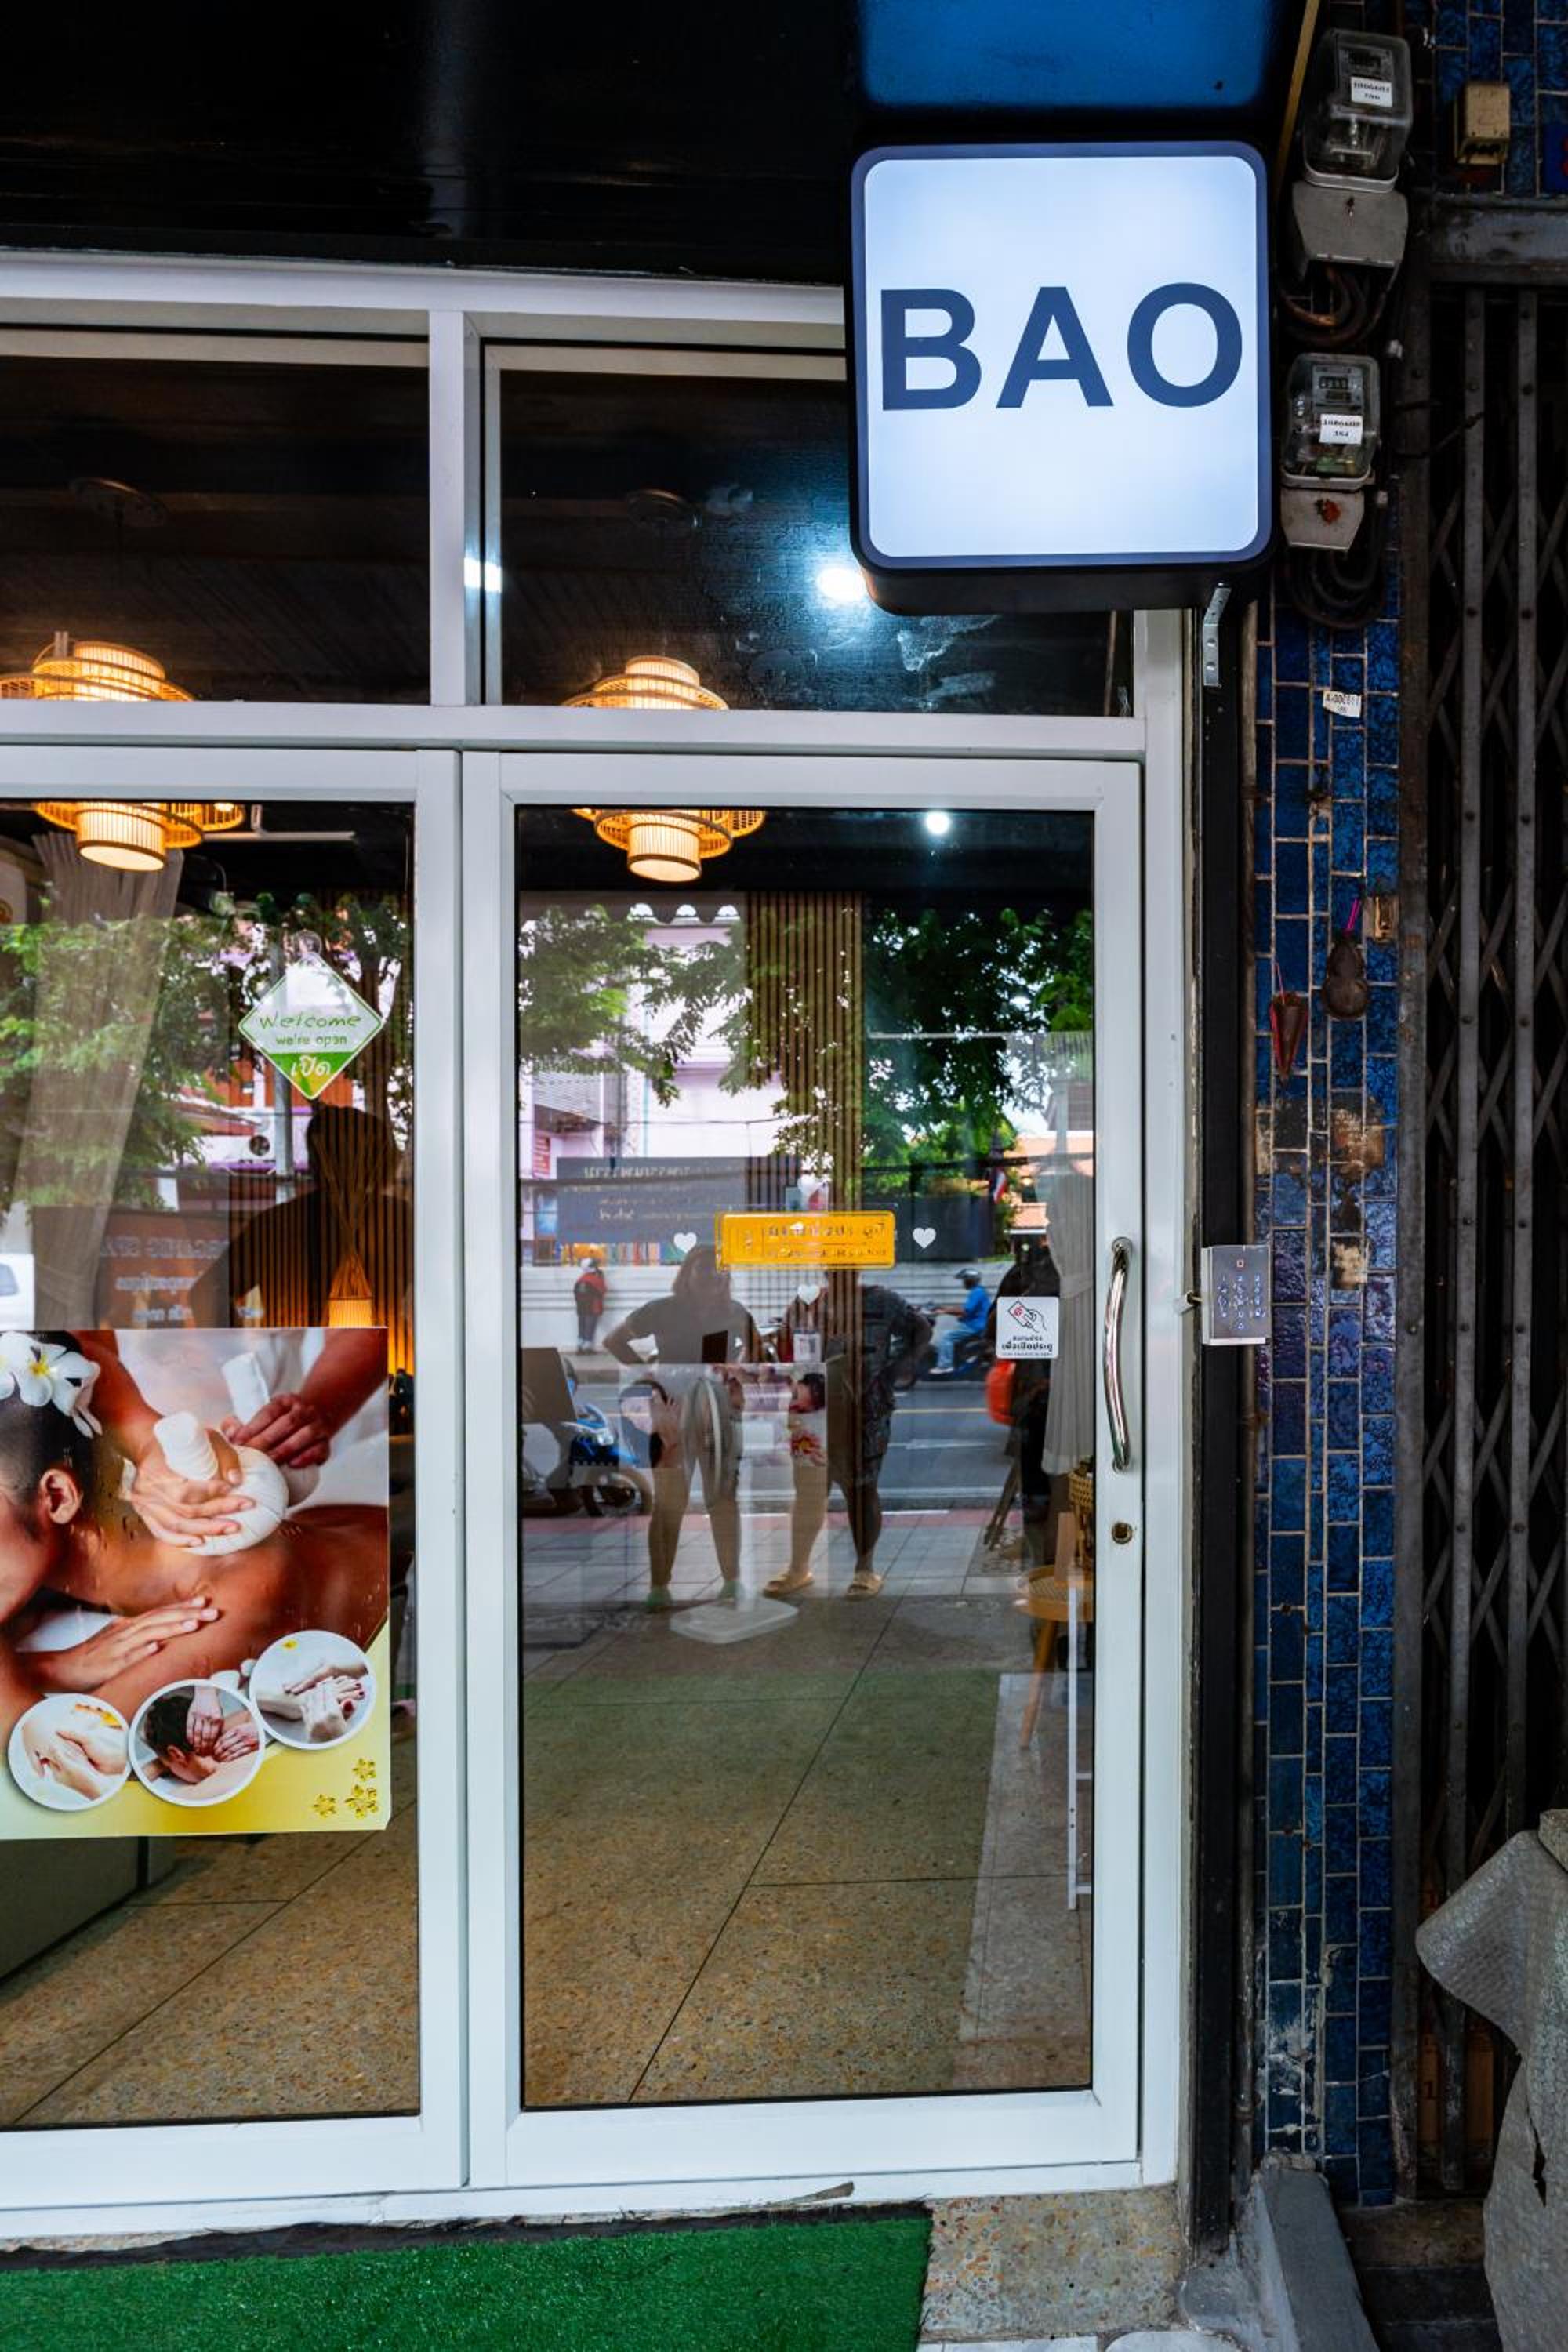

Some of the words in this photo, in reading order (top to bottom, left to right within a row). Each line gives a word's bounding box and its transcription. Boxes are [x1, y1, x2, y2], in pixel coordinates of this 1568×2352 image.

[881, 282, 1243, 411] BAO
[260, 1011, 361, 1029] Welcome
[275, 1033, 310, 1046] we're
[315, 1034, 347, 1048] open
[290, 1054, 332, 1077] เปิด
